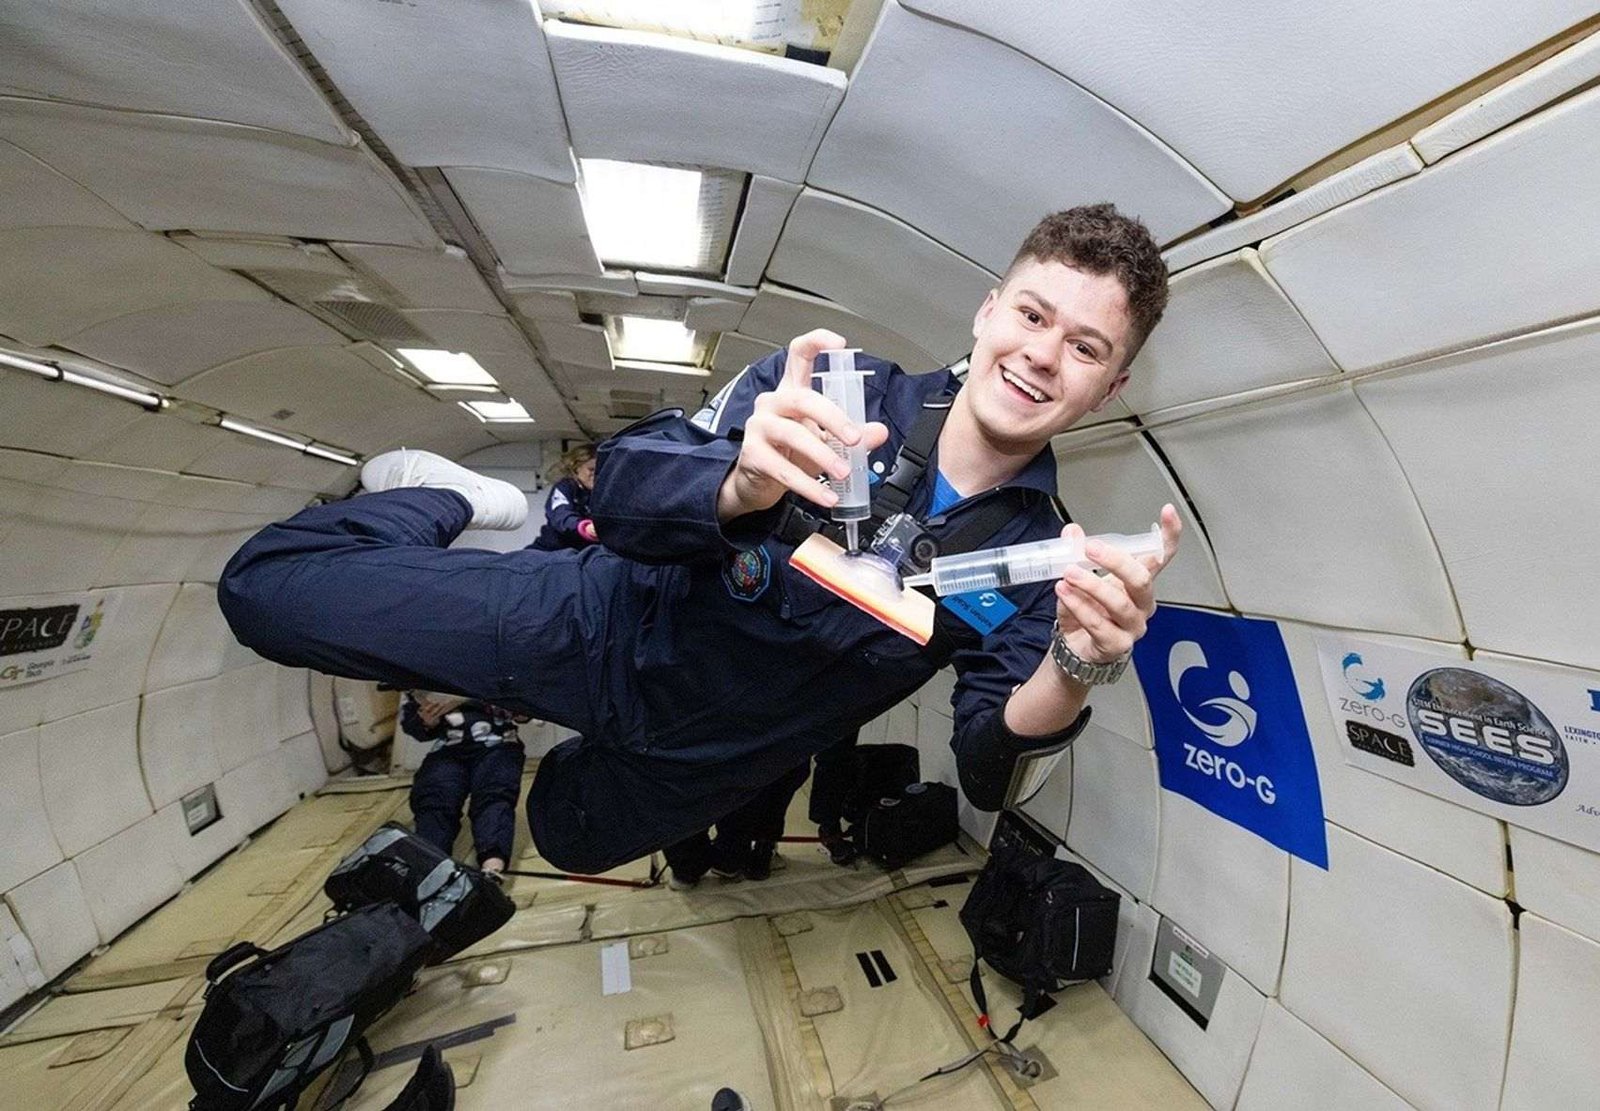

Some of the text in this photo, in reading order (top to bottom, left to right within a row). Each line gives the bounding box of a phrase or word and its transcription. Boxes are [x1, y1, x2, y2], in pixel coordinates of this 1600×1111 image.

[1339, 696, 1407, 729] zero-G
[1494, 717, 1516, 730] Earth
[1348, 724, 1411, 758] SPACE
[1418, 709, 1555, 766] SEES
[1183, 742, 1276, 805] zero-G
